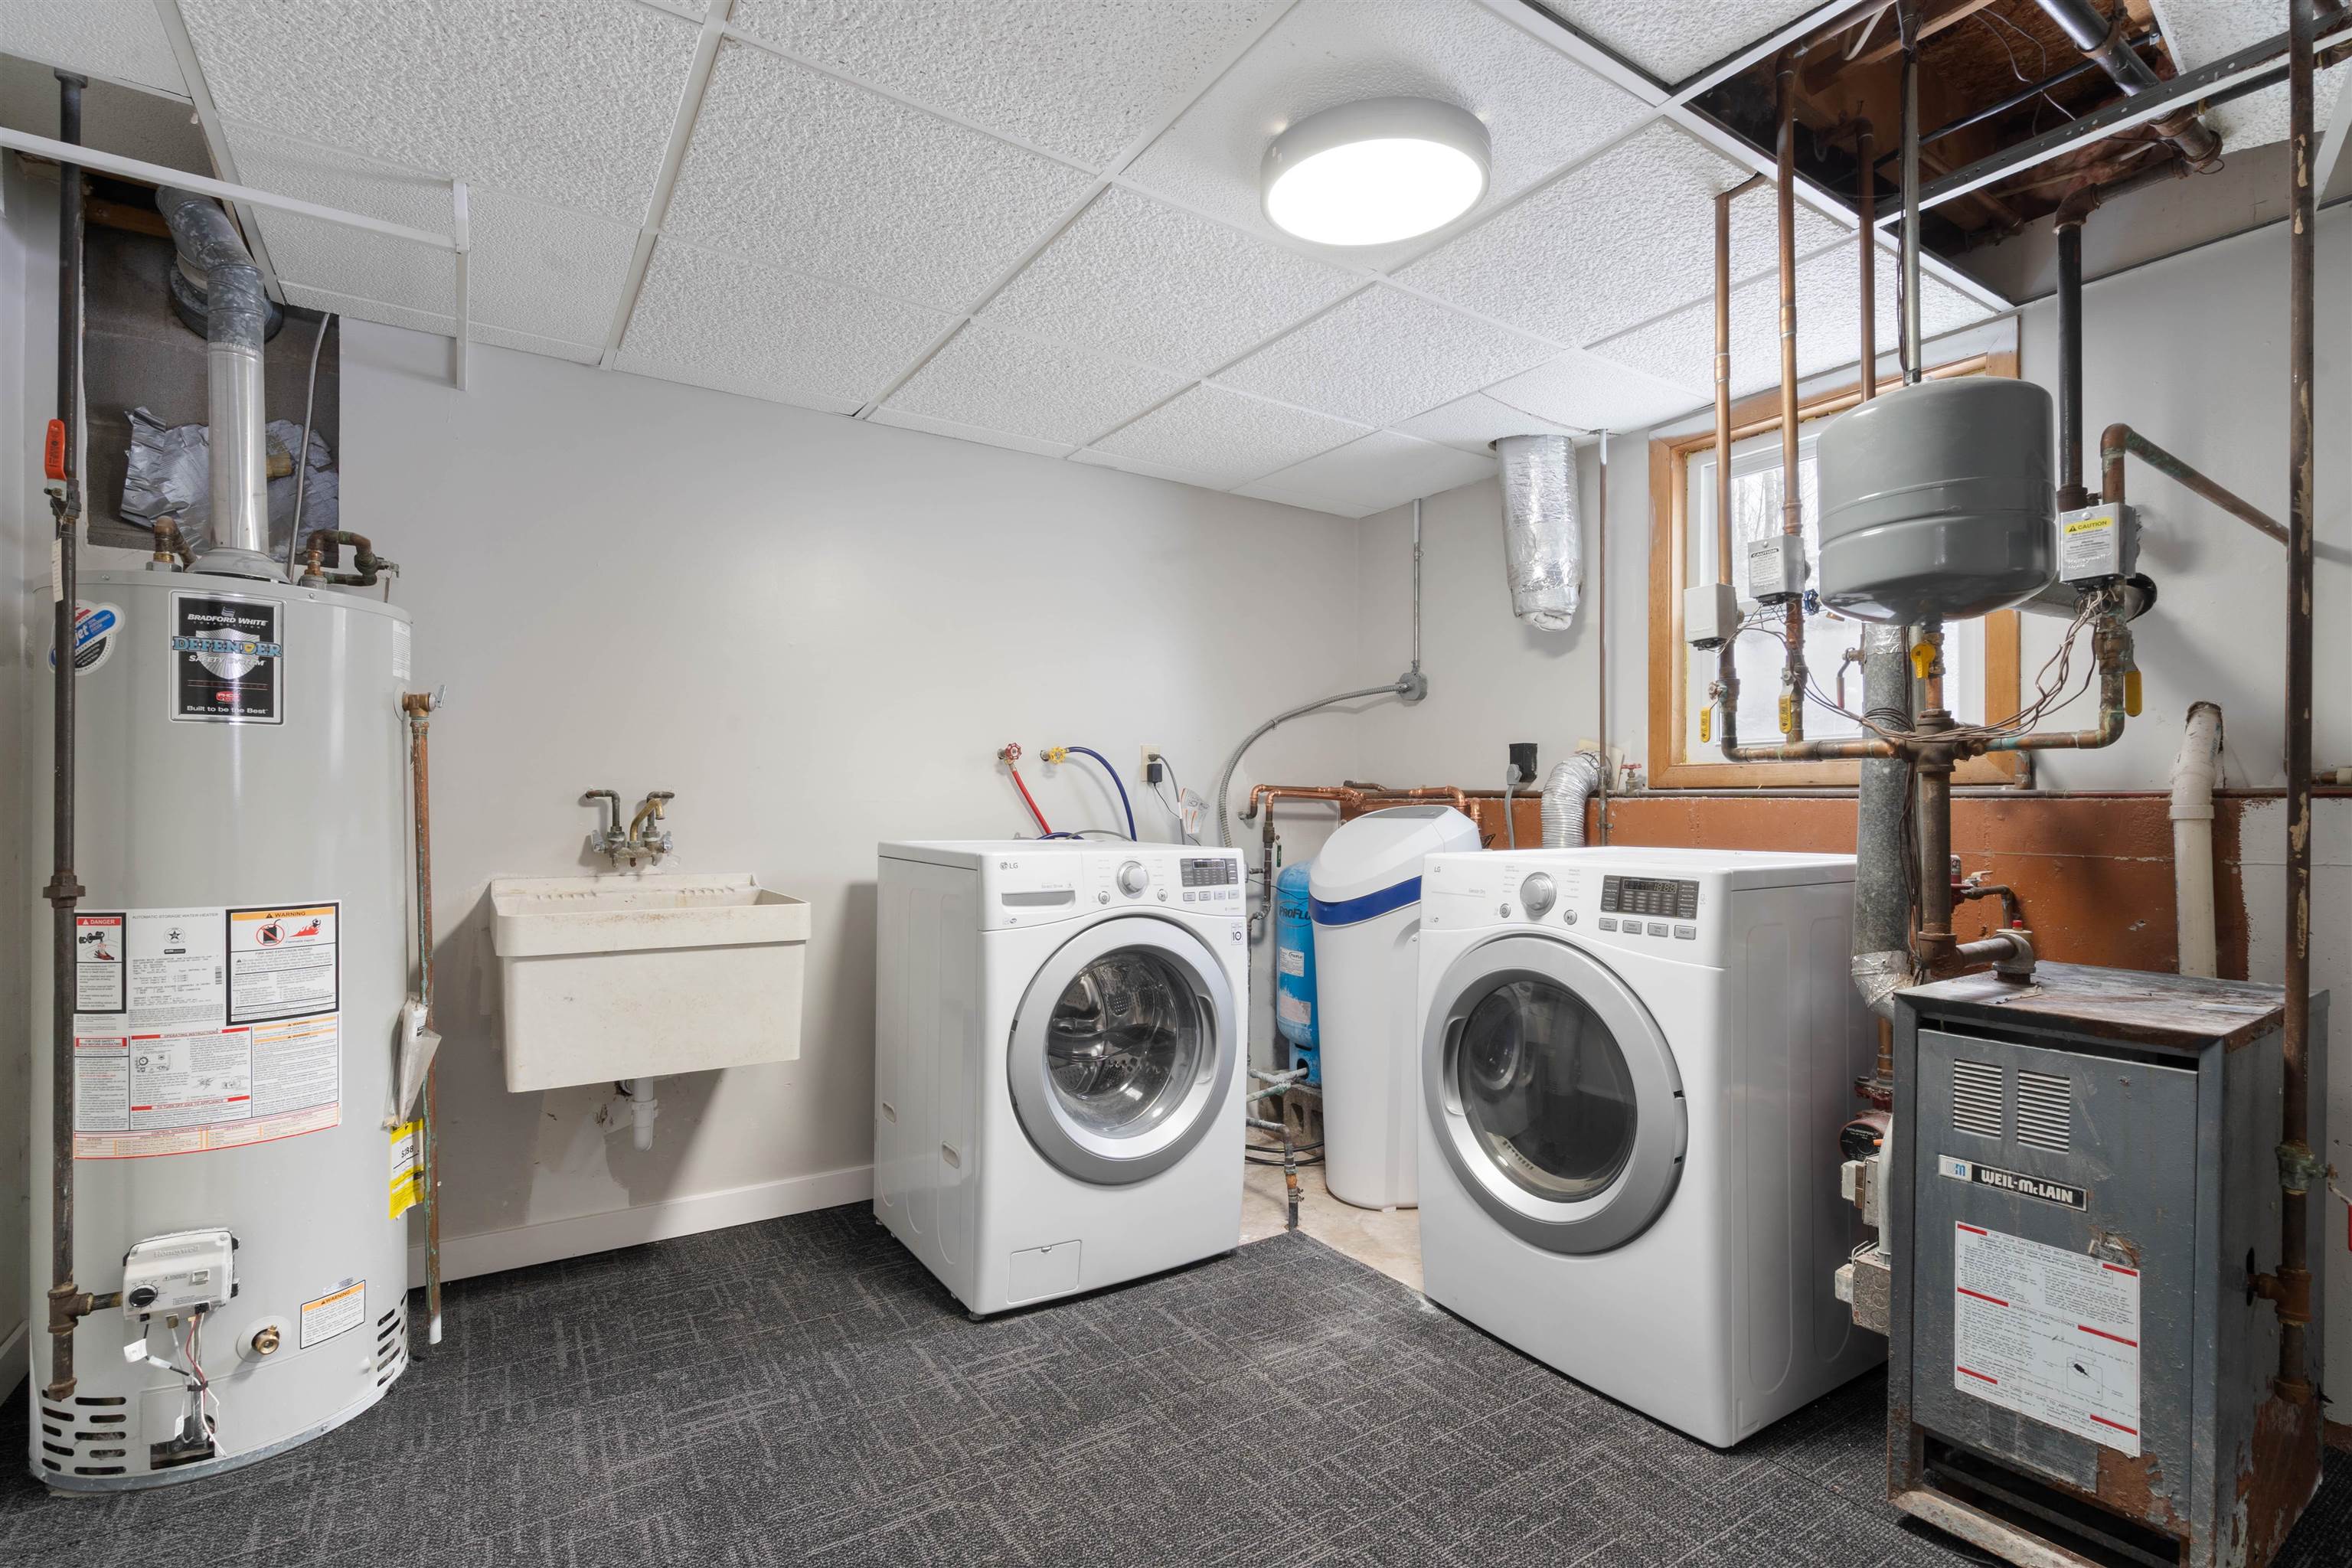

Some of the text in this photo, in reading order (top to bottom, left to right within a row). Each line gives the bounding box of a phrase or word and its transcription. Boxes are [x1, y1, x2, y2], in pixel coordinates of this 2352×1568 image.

[2078, 521, 2107, 530] CAUTION
[1753, 548, 1777, 557] CAUTION
[187, 613, 268, 626] BRADFORD WHITE
[172, 635, 283, 657] DEFENDER
[188, 655, 224, 663] SAFETY
[1981, 1169, 2073, 1204] WEIL-McLAIN
[153, 1245, 200, 1258] Honeywell
[325, 1289, 351, 1302] WARNING
